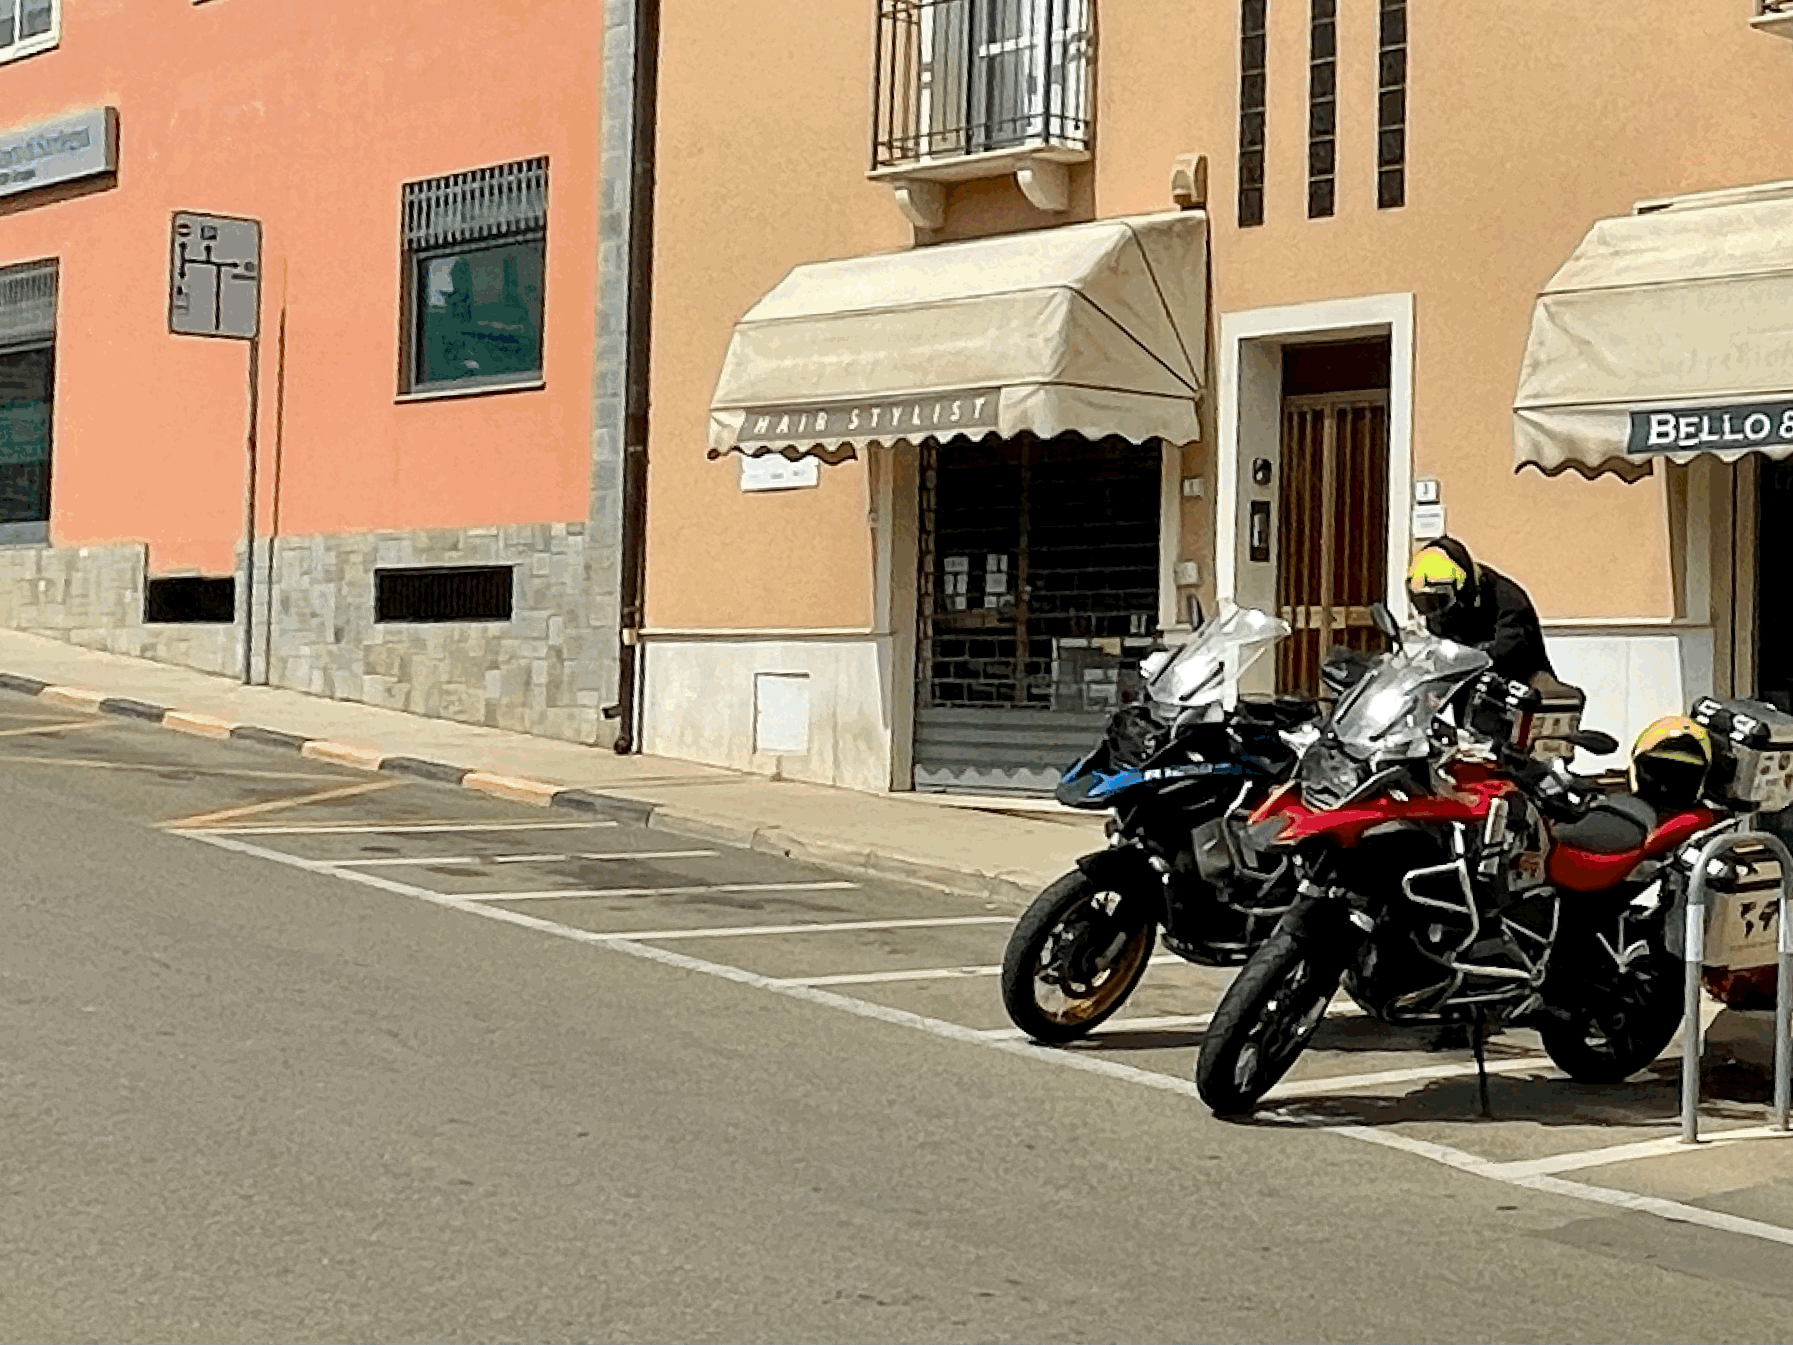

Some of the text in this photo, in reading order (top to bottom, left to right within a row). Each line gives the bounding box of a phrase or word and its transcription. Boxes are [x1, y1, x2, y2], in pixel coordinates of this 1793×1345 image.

[753, 397, 986, 434] HAIR STYLIST
[1648, 412, 1771, 447] BELLO
